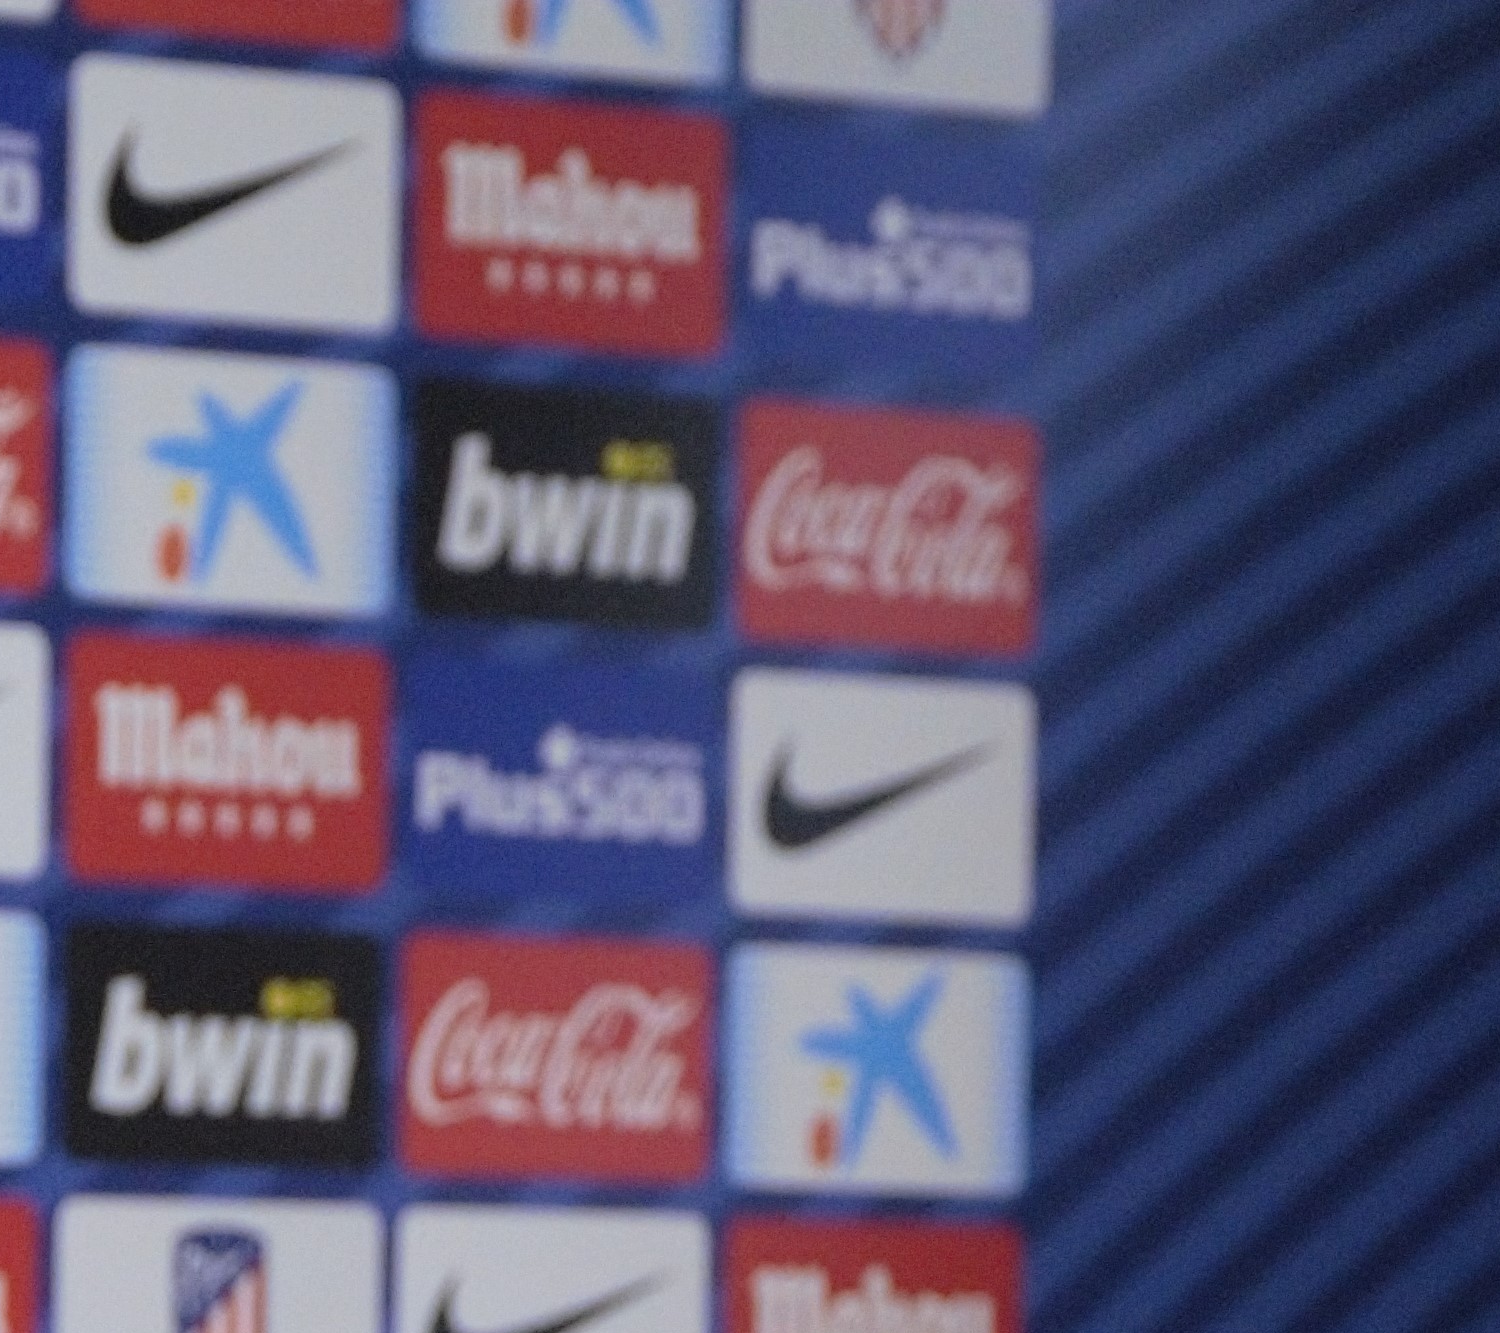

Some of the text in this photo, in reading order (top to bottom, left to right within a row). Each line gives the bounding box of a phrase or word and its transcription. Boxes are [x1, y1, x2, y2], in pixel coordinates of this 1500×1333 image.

[444, 143, 700, 262] Mahou
[439, 435, 694, 581] bwin
[745, 448, 1020, 601] Coca-Cola
[96, 684, 361, 791] Mahou
[92, 977, 355, 1117] bwin
[409, 980, 697, 1129] Coca-Cola
